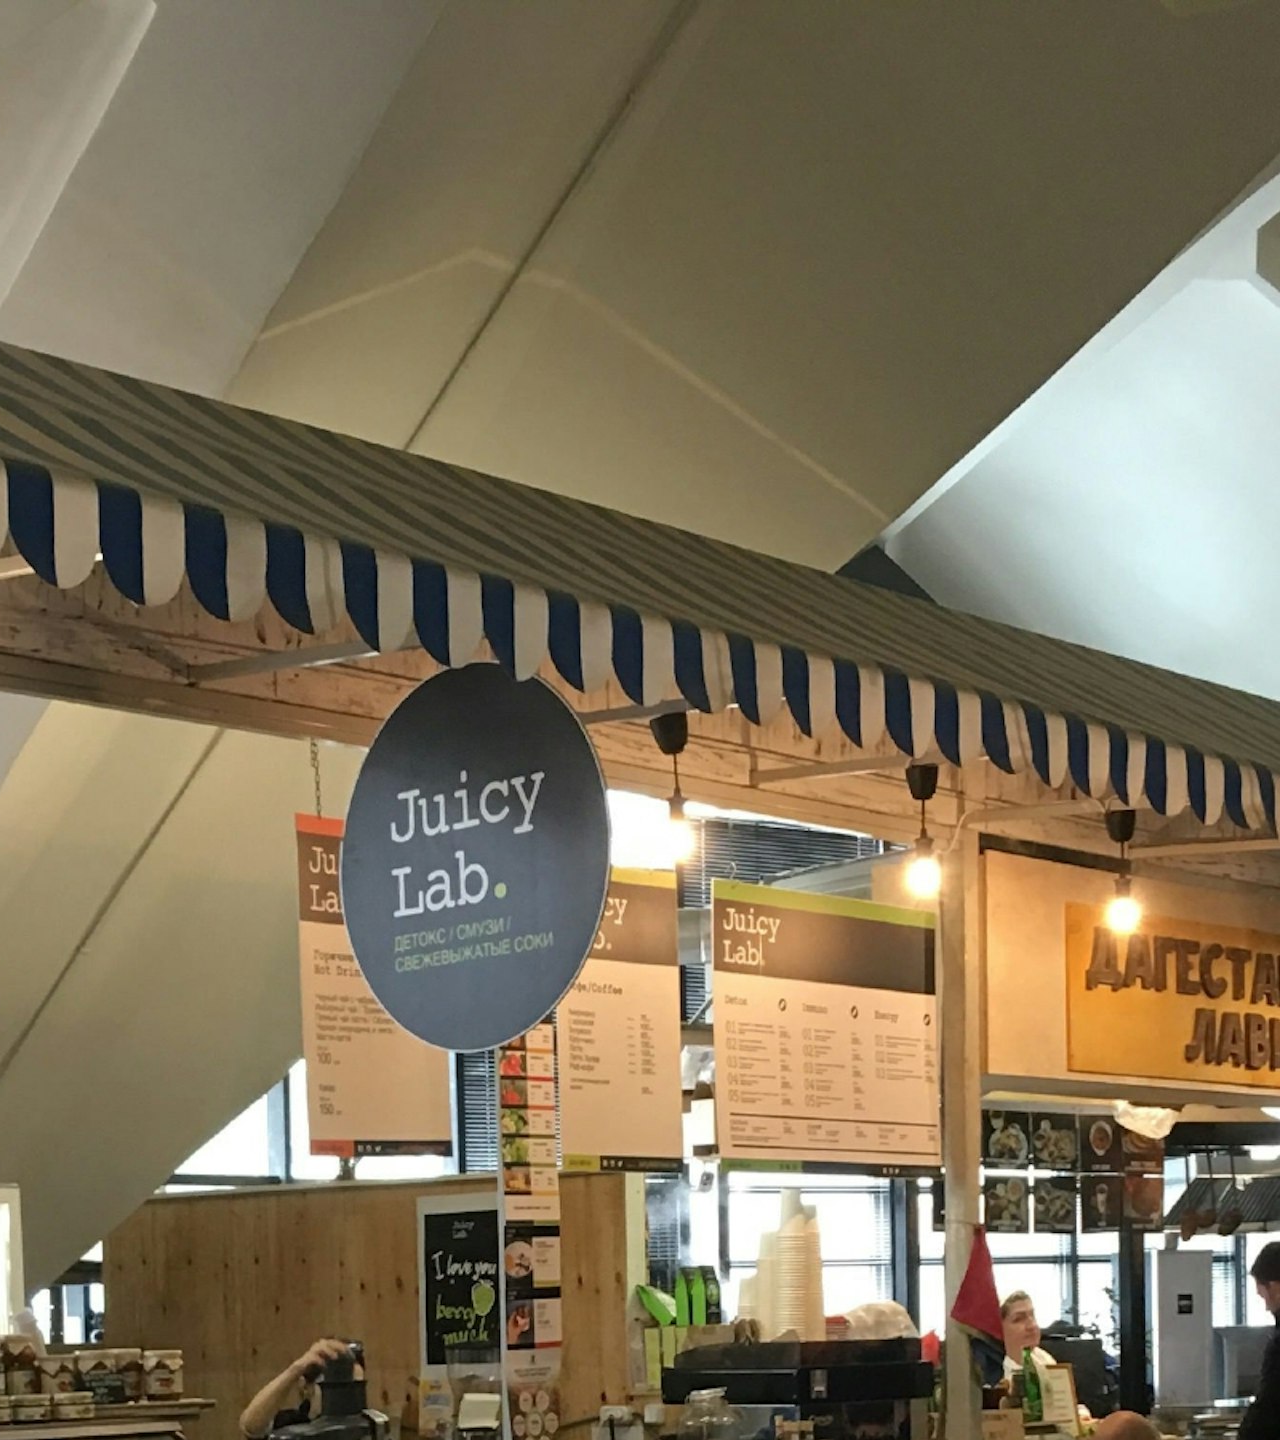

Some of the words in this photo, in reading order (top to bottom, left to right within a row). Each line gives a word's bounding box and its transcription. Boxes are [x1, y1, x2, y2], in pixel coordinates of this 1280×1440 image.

[389, 769, 545, 843] Juicy
[390, 850, 508, 918] Lab.
[393, 927, 446, 954] ДЕТОКС
[455, 917, 506, 941] СМУЗИ
[722, 906, 782, 943] Juicy
[394, 938, 511, 973] СВЕЖЕВЫЖАТЫЕ
[513, 930, 554, 953] СОКИ
[431, 1250, 445, 1281] I
[446, 1253, 473, 1276] love
[472, 1260, 497, 1282] you
